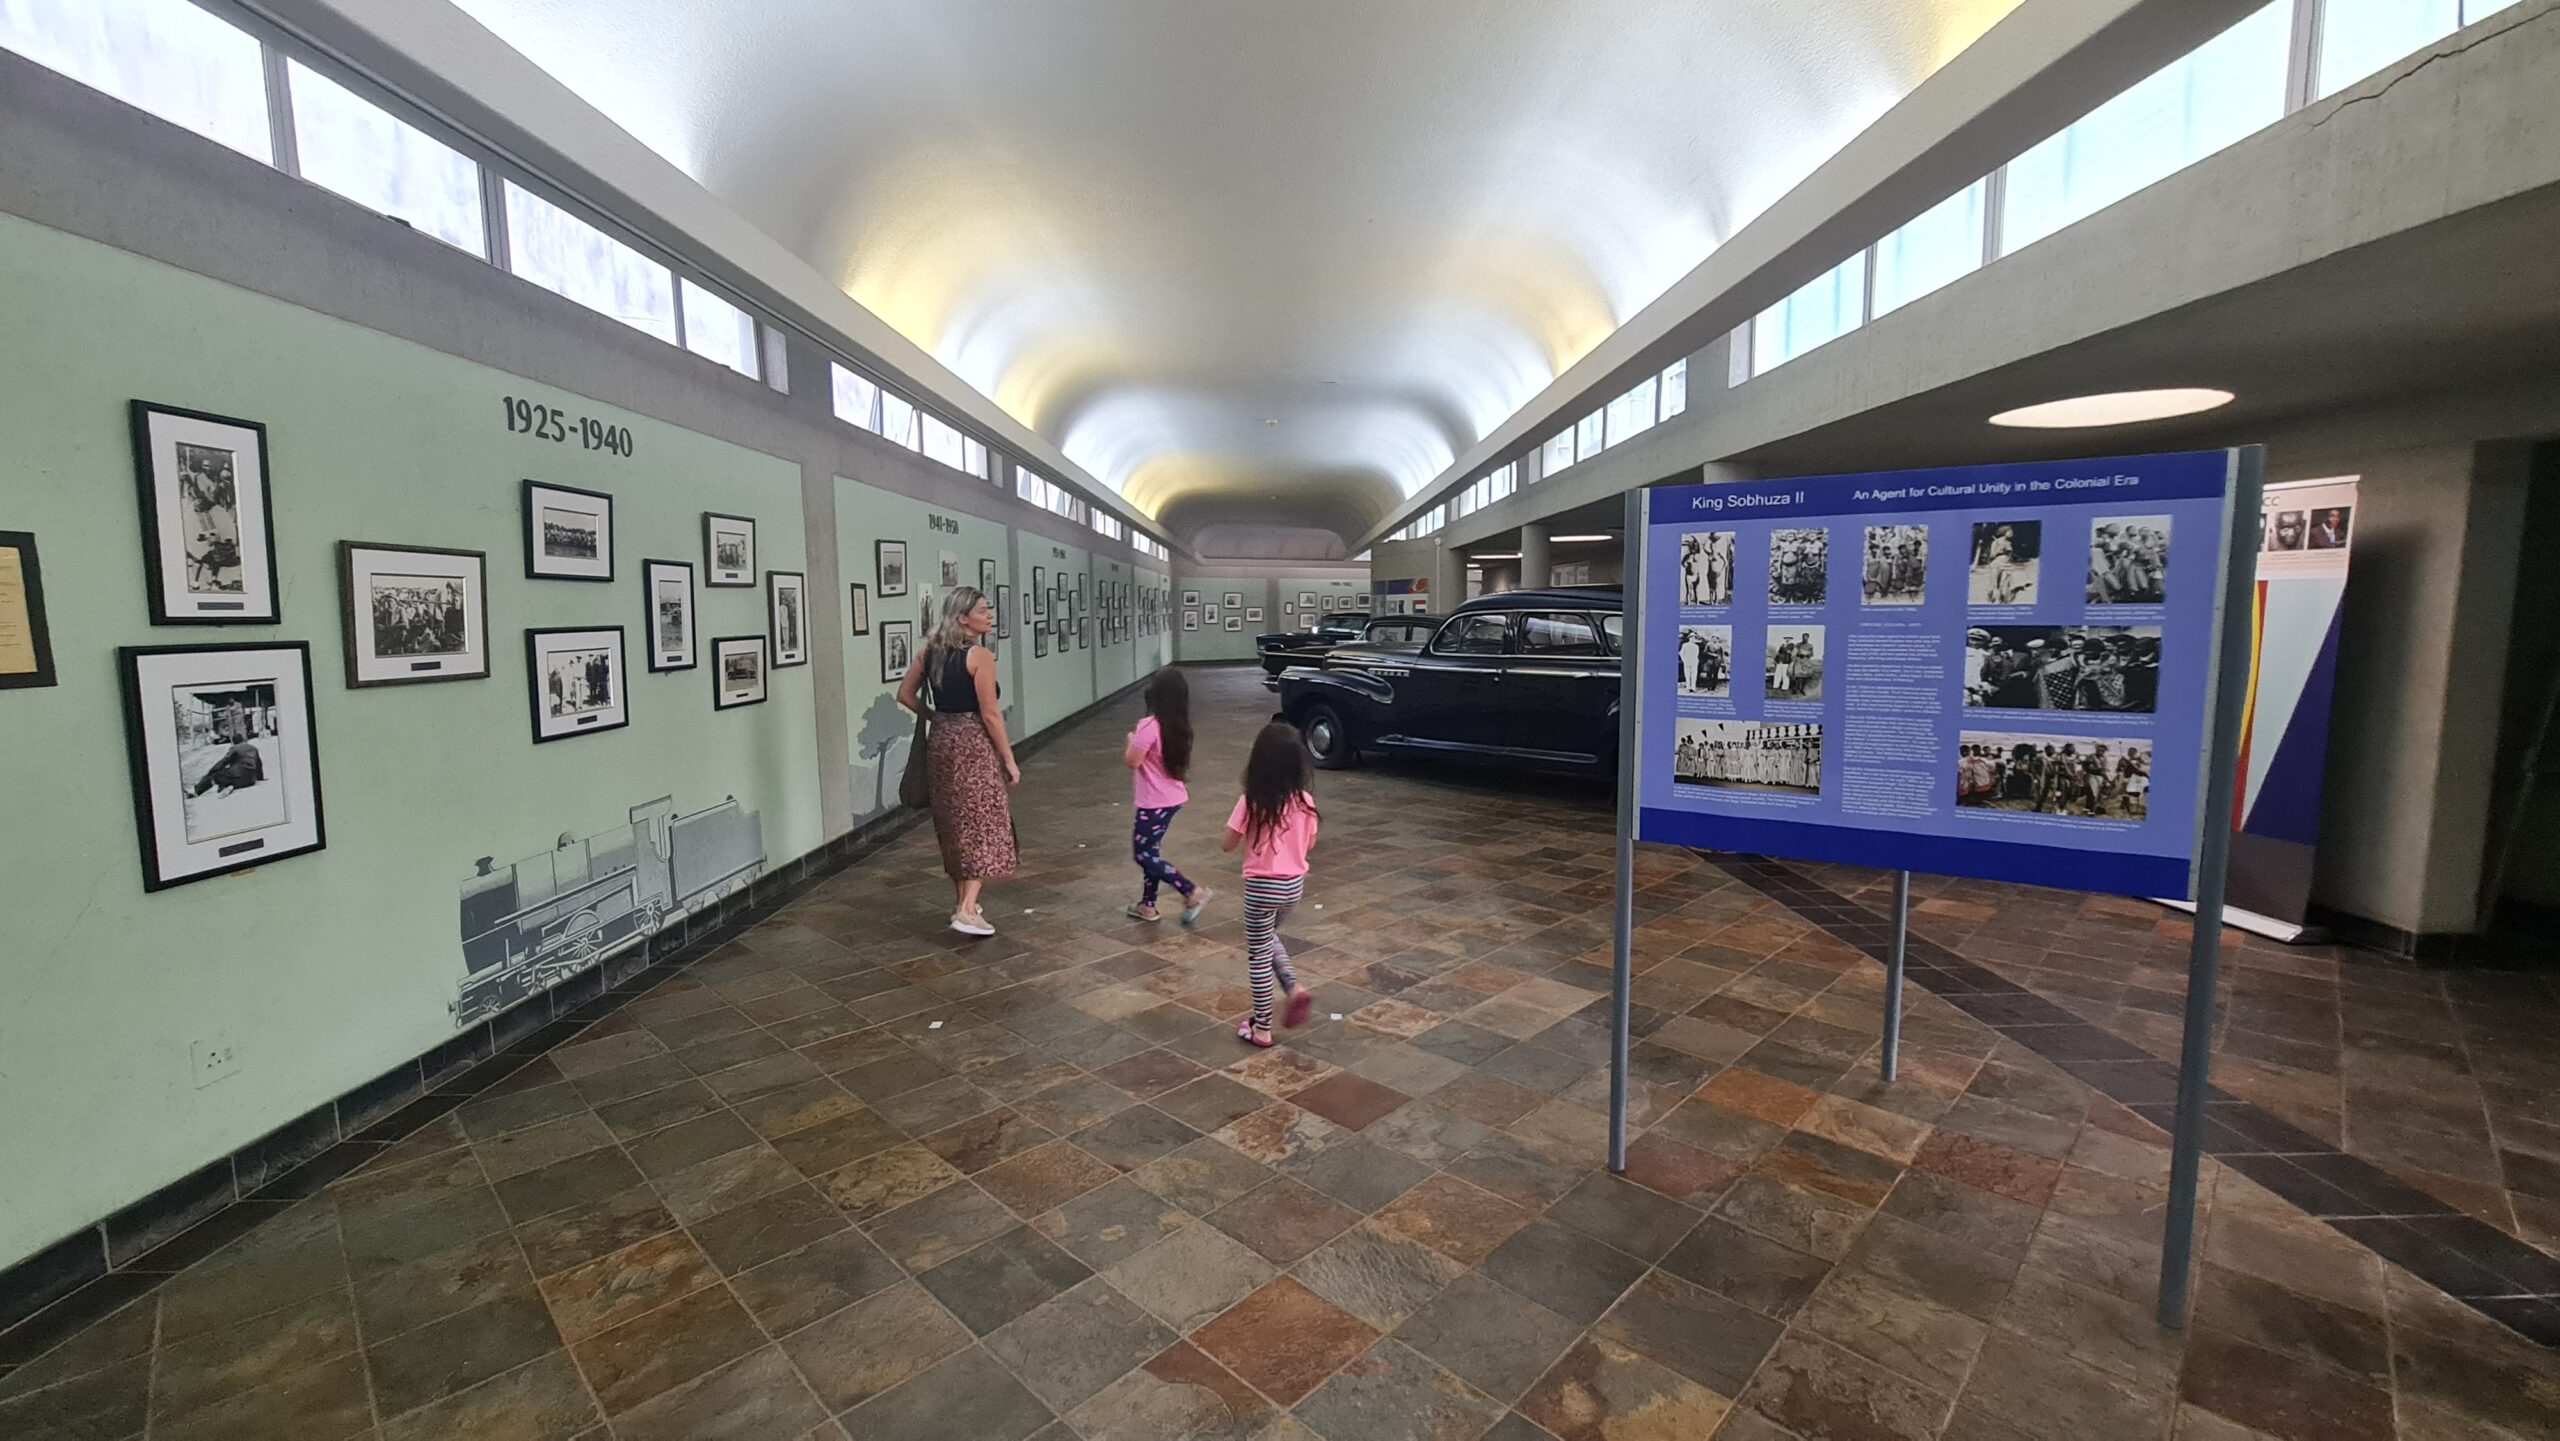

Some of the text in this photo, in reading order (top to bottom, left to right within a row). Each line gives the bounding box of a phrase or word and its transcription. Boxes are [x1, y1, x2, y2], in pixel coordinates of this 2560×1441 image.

[503, 396, 633, 458] 1925-1940
[1692, 491, 1805, 511] King Sobhuza II
[1853, 475, 2140, 501] An Agent for Cultural Unity in the Colonial Era
